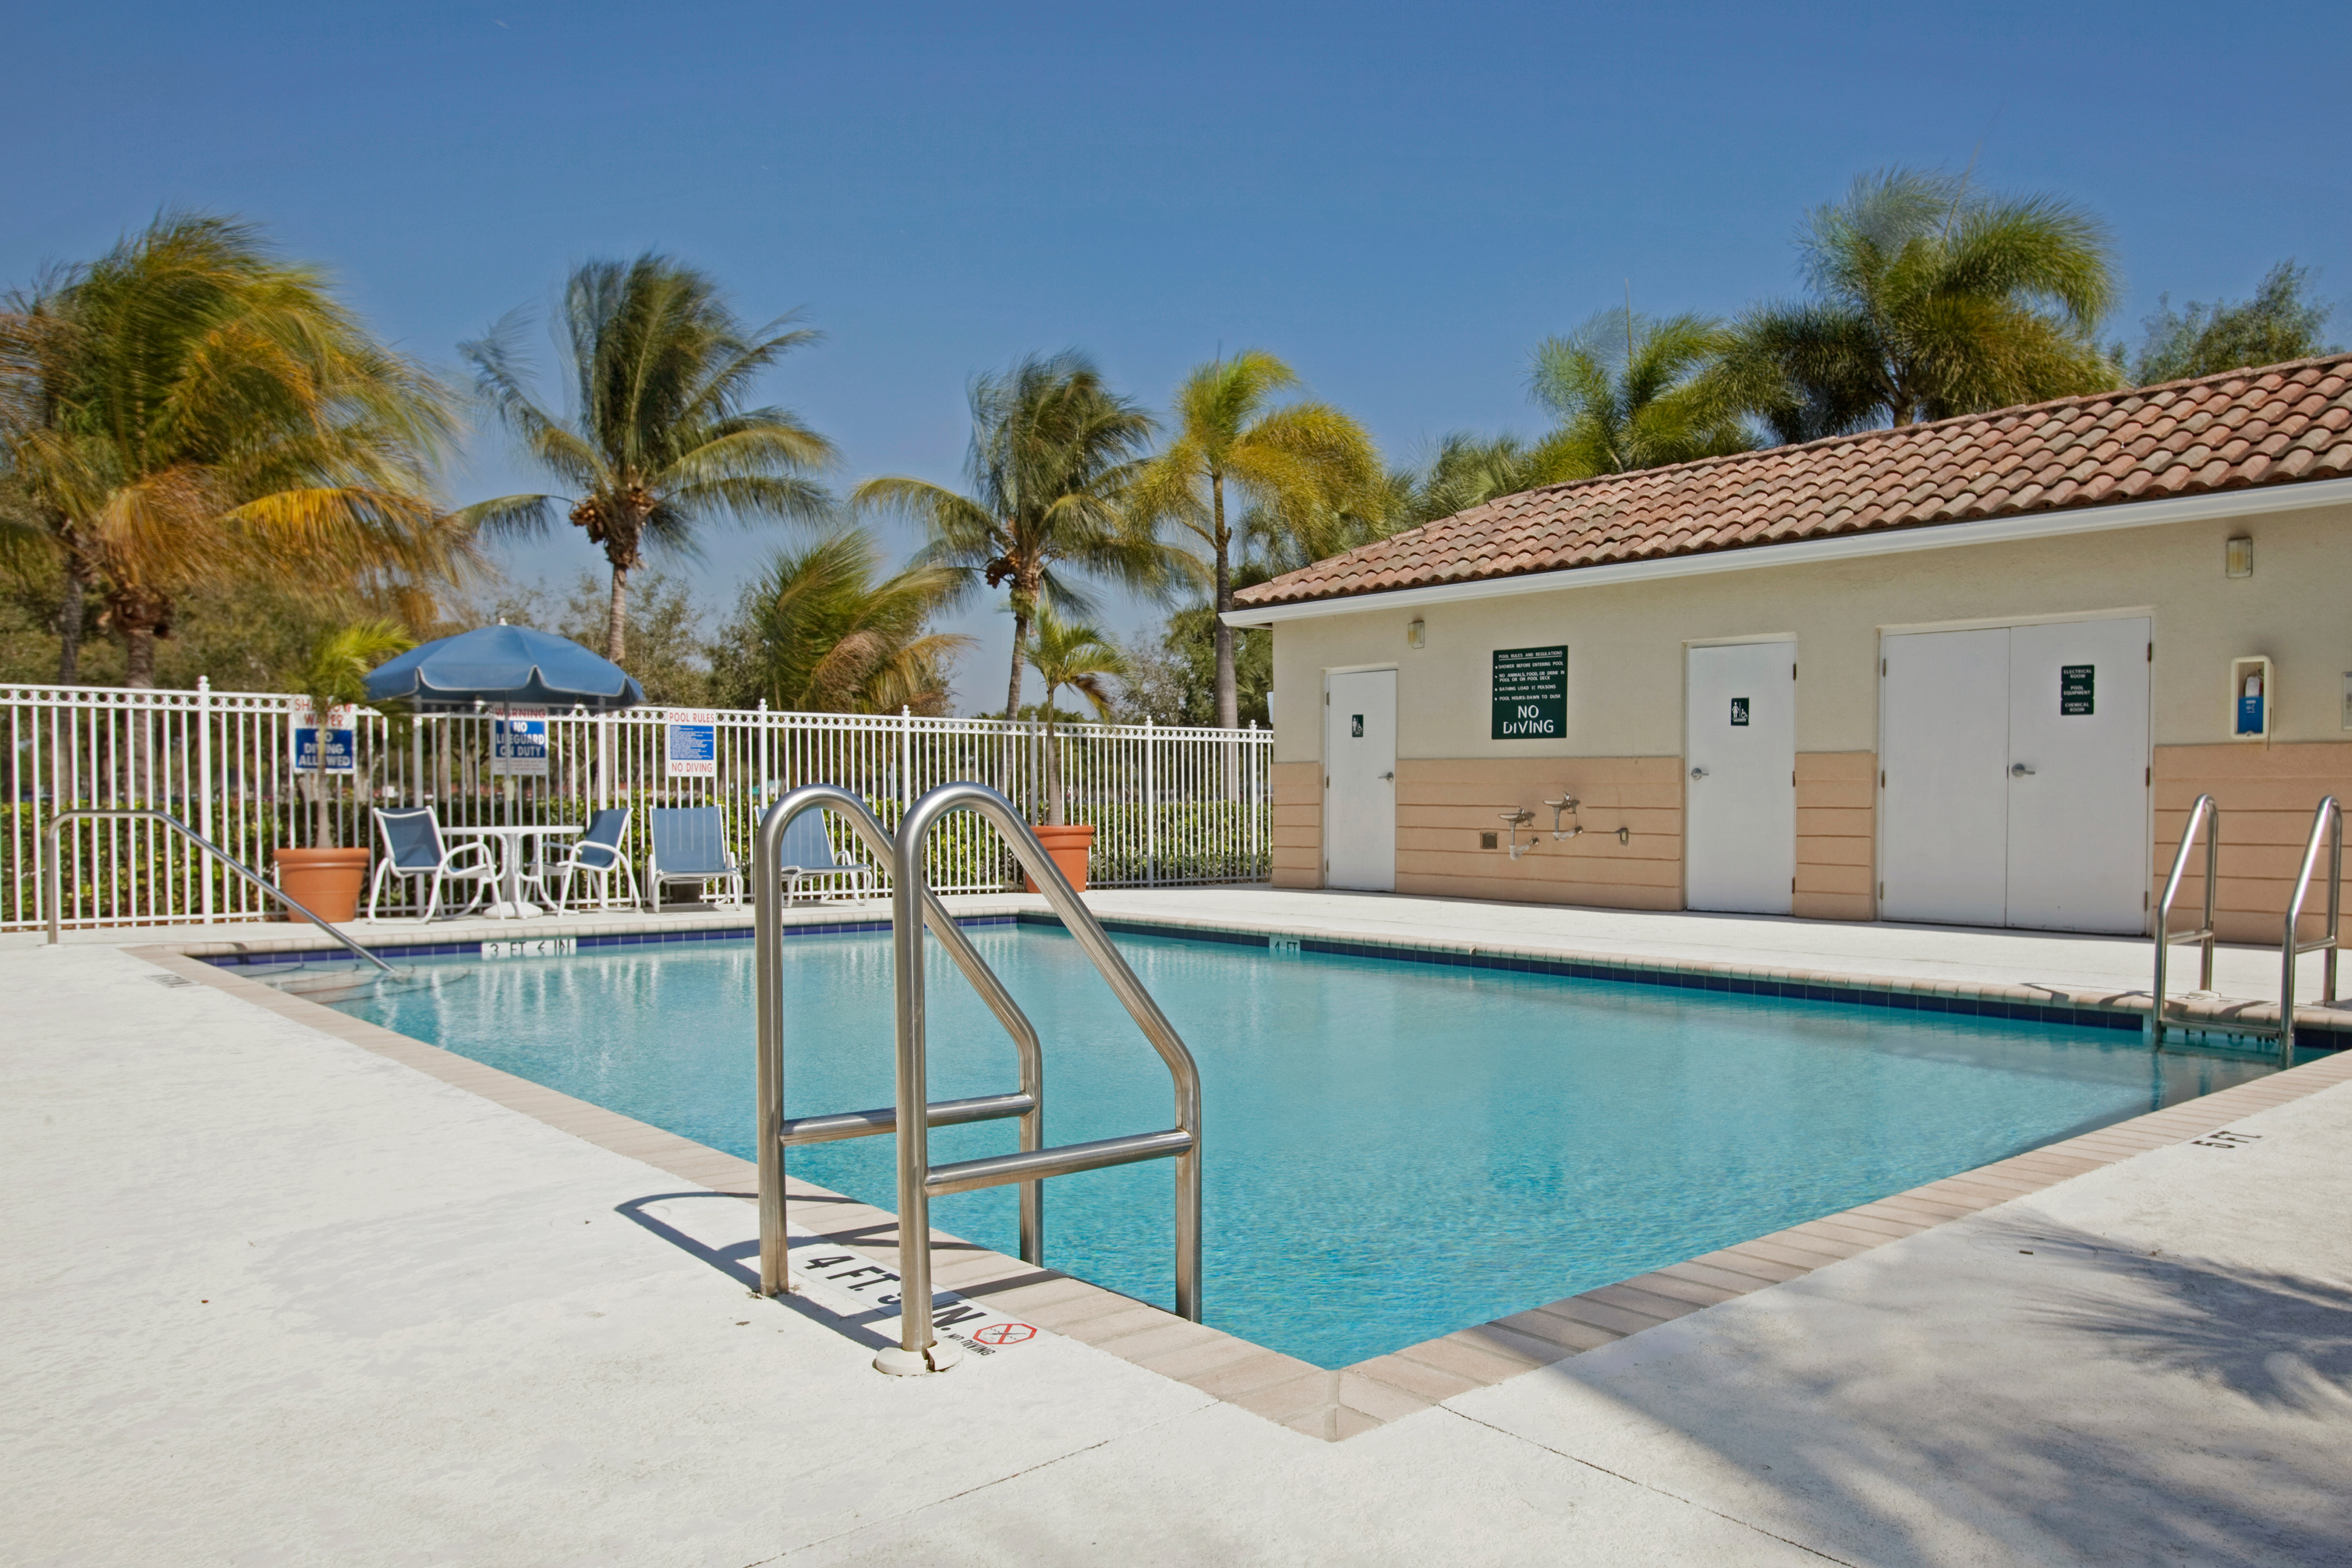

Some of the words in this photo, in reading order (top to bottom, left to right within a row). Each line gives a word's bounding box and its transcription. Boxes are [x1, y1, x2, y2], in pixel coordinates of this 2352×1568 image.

[495, 707, 546, 719] WRNING
[1518, 705, 1539, 718] NO
[669, 712, 689, 722] POOL
[693, 713, 714, 723] RULES
[514, 722, 528, 733] NO
[1503, 719, 1554, 734] DIVING
[496, 734, 545, 745] LIEGUARD
[517, 746, 541, 756] DUTY
[298, 755, 351, 766] ALLWED
[672, 762, 683, 772] NO
[686, 763, 712, 772] DIVING
[804, 1255, 857, 1270] 4
[960, 1339, 996, 1356] DIVING
